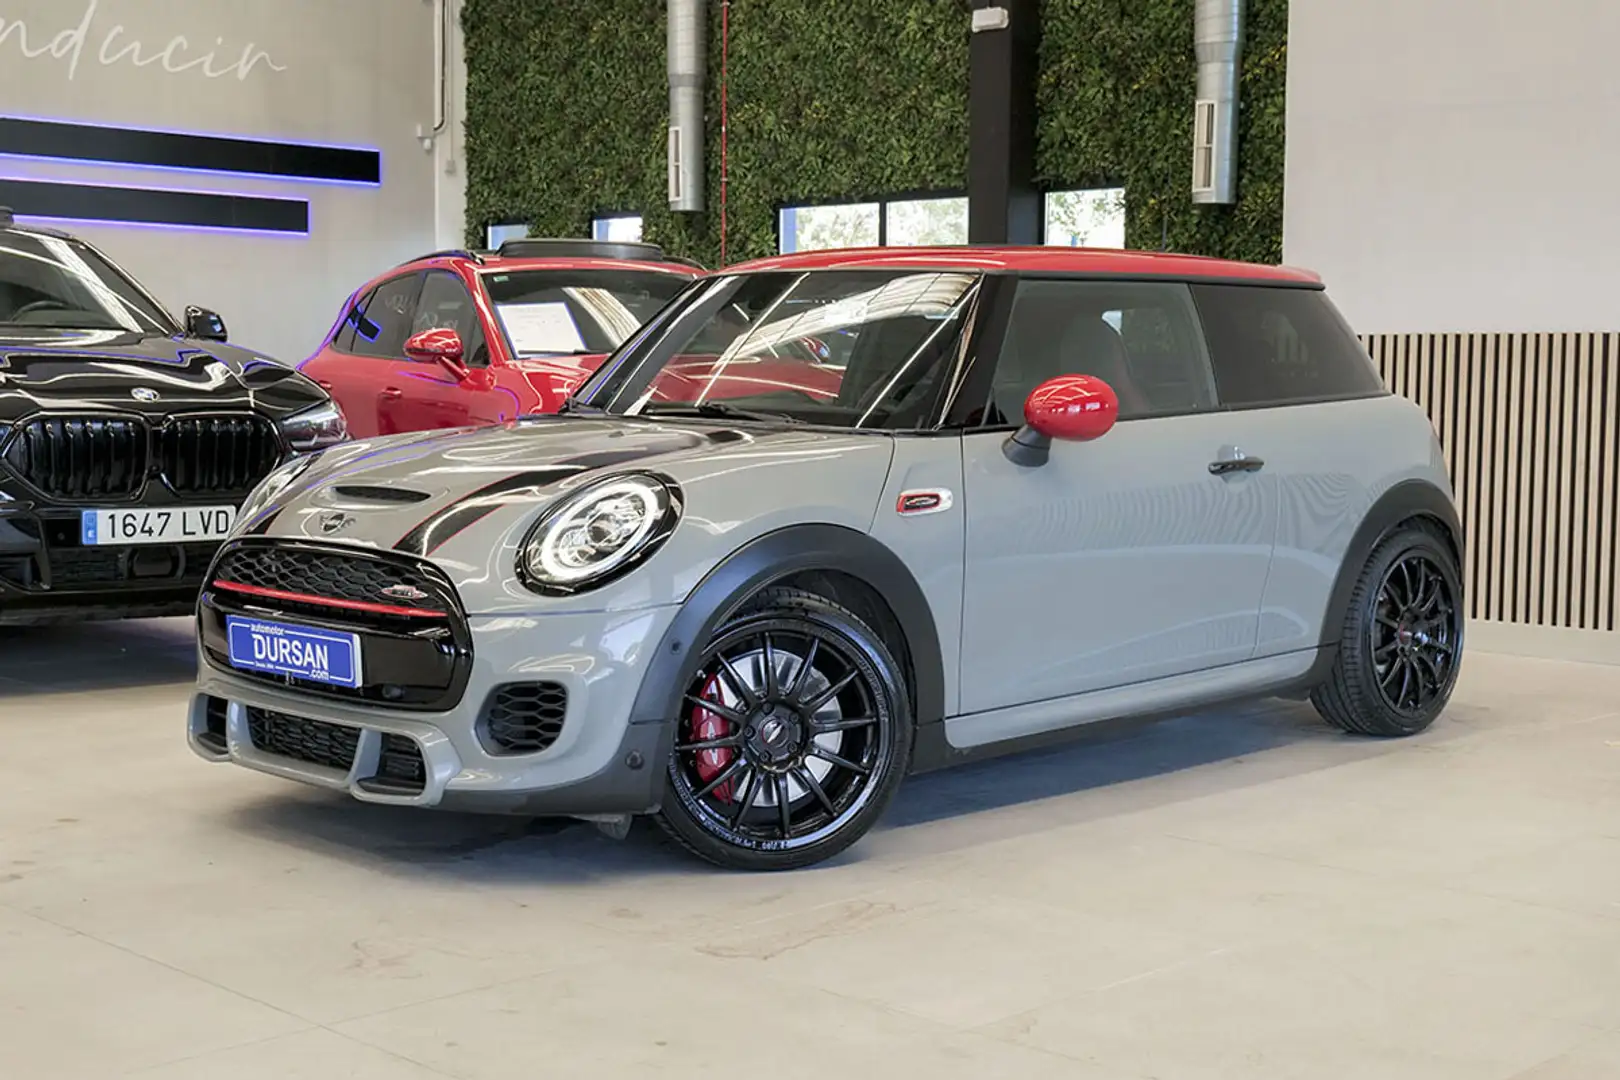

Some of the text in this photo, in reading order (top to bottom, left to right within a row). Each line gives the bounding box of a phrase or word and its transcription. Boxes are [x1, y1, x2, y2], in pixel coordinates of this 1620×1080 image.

[108, 510, 229, 539] 1647 LVD
[251, 633, 328, 671] DURSAN
[309, 668, 330, 681] .com
